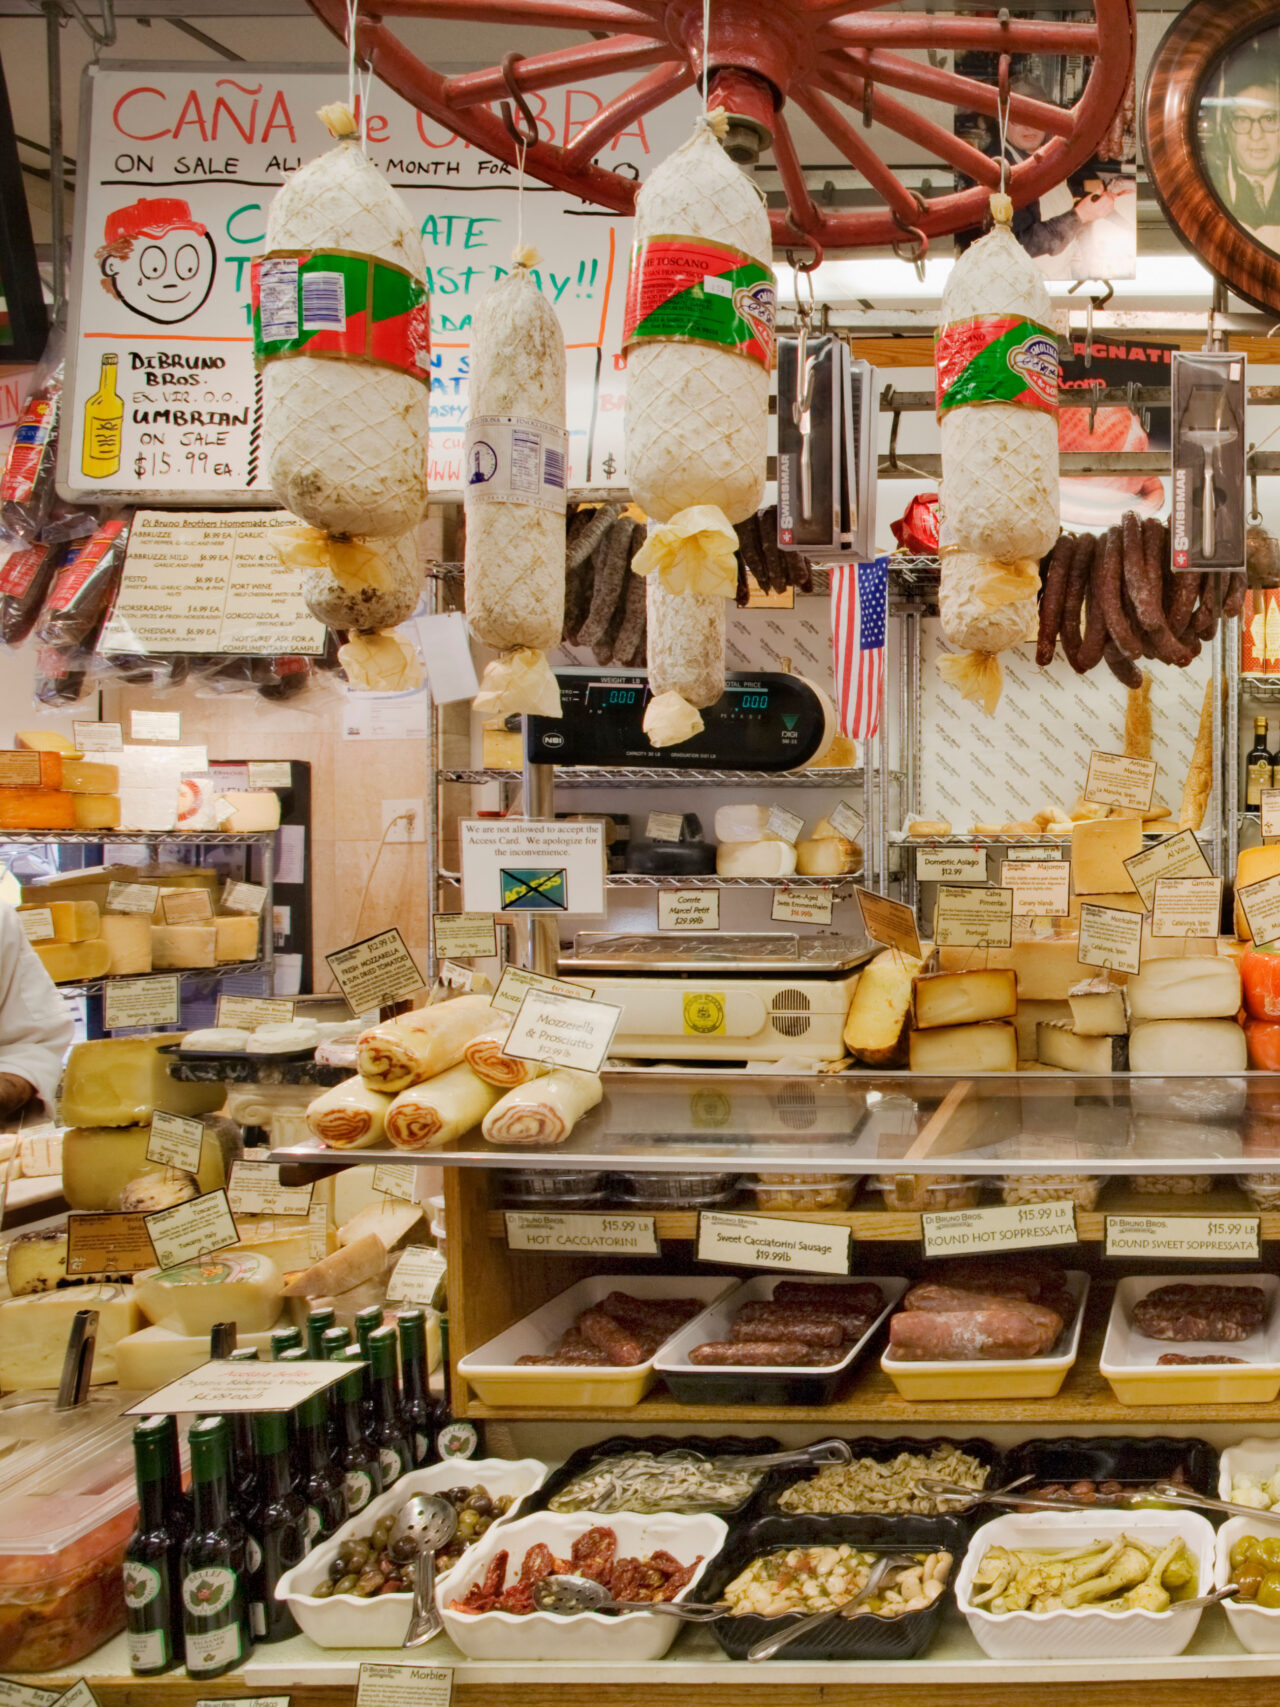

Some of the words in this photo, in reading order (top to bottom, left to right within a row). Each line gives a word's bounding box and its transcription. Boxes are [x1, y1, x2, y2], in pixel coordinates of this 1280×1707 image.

[112, 79, 297, 145] CAÑA
[114, 154, 154, 174] ON
[174, 156, 239, 175] SALE
[386, 157, 461, 175] MONTH
[477, 160, 512, 175] FOR
[132, 406, 250, 426] UMBRIAN
[140, 432, 166, 446] ON
[179, 431, 230, 447] SALE
[134, 451, 209, 480] $15.99
[780, 454, 795, 530] SWISSMAR
[1174, 469, 1190, 551] SWISSMAR
[154, 519, 180, 528] Bruno
[182, 518, 217, 528] Brothers
[219, 519, 267, 528] Homemade
[466, 825, 480, 833] We
[512, 824, 545, 833] allowed
[557, 826, 584, 835] accept
[586, 824, 599, 833] the
[469, 837, 497, 845] Access
[499, 836, 520, 845] Card.
[542, 837, 583, 847] apologize
[585, 836, 597, 845] for
[494, 849, 507, 857] the
[509, 849, 571, 857] inconvenience.
[1017, 1207, 1052, 1223] $15.99
[1055, 1208, 1066, 1218] LB
[601, 1218, 636, 1232] $15.99
[638, 1223, 649, 1231] LB
[1207, 1221, 1242, 1236] $15.99
[1244, 1225, 1256, 1234] LB
[527, 1234, 552, 1245] HOT
[556, 1235, 638, 1247] CACCIATORINI
[927, 1233, 970, 1248] ROUND
[972, 1231, 997, 1243] HOT
[999, 1223, 1075, 1241] SOPPRESSATA
[716, 1232, 742, 1243] Sweet
[743, 1235, 797, 1250] Cacciatorini
[798, 1241, 833, 1256] Sausage
[1111, 1239, 1150, 1248] ROUND
[1151, 1240, 1185, 1249] SWEET
[1186, 1240, 1254, 1250] SOPPRESSATA
[755, 1249, 792, 1262] $19.99lb
[410, 1668, 448, 1681] Morbier
